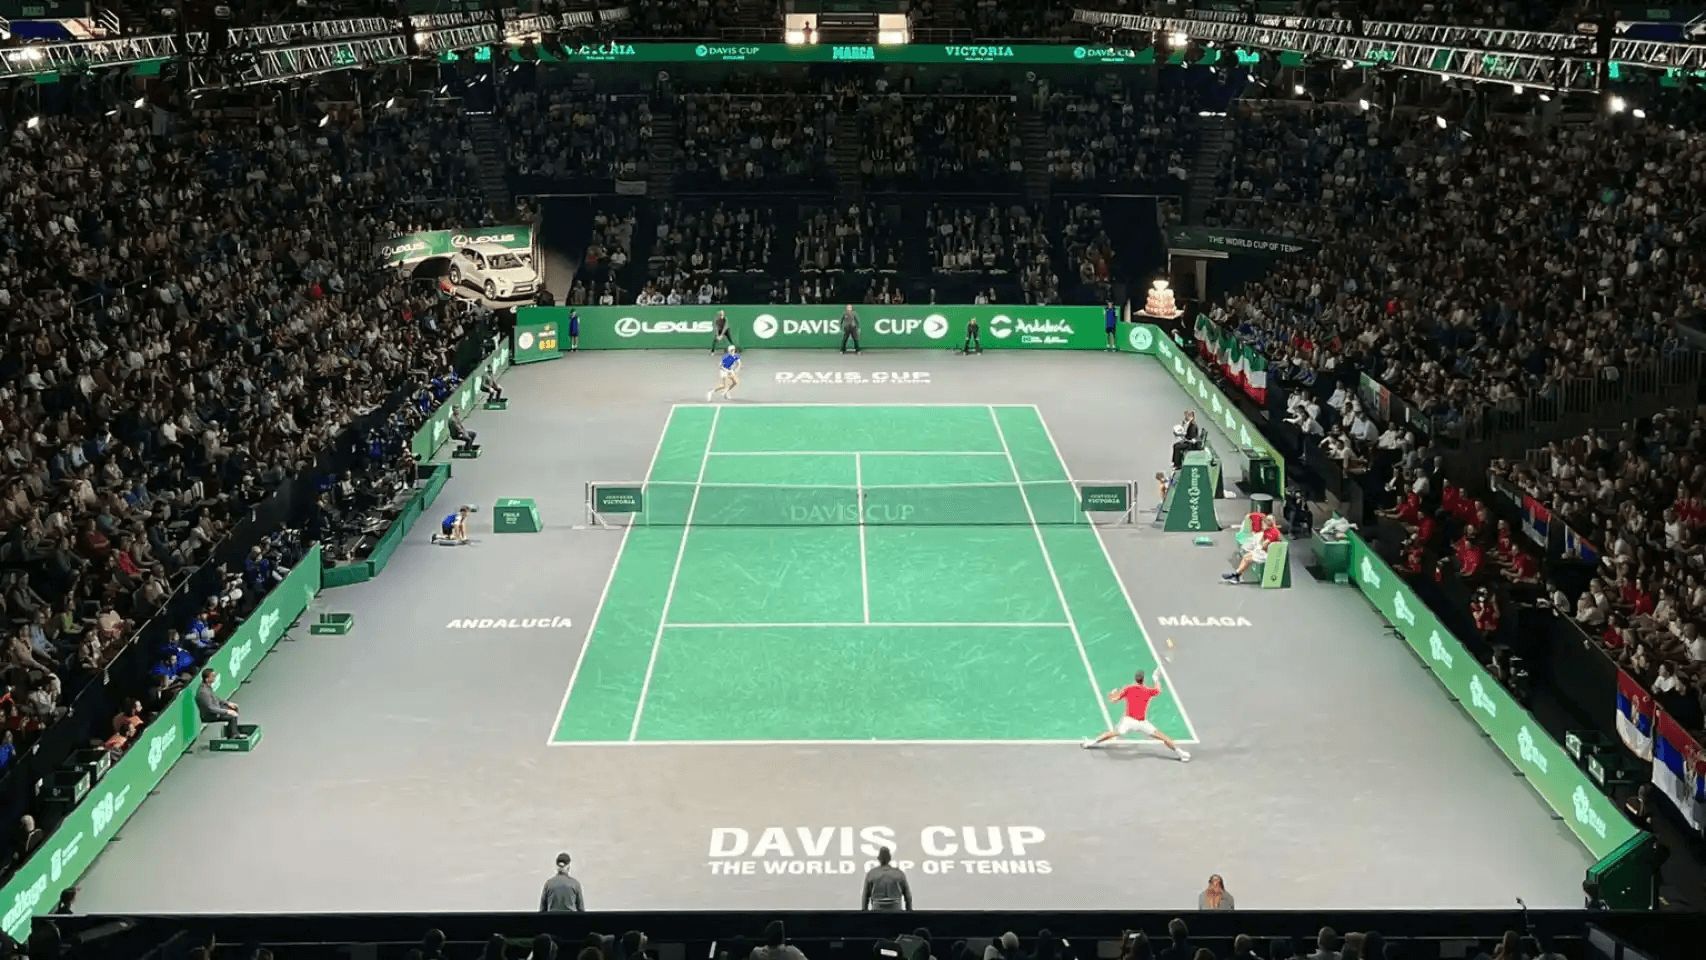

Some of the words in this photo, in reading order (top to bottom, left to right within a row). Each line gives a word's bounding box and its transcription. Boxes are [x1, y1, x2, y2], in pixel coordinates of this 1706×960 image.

[709, 47, 737, 55] DAVIS
[739, 47, 760, 55] CUP
[833, 46, 875, 60] MARCA
[945, 46, 1014, 57] VICTORIA
[468, 233, 515, 243] LEXUS
[1208, 235, 1225, 245] THE
[1225, 237, 1253, 248] WORLD
[1253, 240, 1268, 250] CUP
[1269, 242, 1279, 251] OF
[641, 321, 713, 333] LEXUS
[783, 319, 841, 335] DAVIS
[874, 318, 919, 335] CUP
[775, 371, 862, 381] DAVIS
[871, 371, 931, 381] CUP
[790, 504, 858, 521] DAVIS
[866, 504, 915, 521] CUP
[446, 616, 572, 629] ANDALUCÍA
[1158, 614, 1253, 627] MÁLAGA
[708, 826, 897, 858] DAVIS
[920, 826, 1047, 857] CUP
[708, 860, 757, 875] THE
[763, 860, 856, 875] WORLD
[863, 860, 915, 873] CP
[922, 860, 955, 875] OF
[959, 860, 1053, 875] TENNIS
